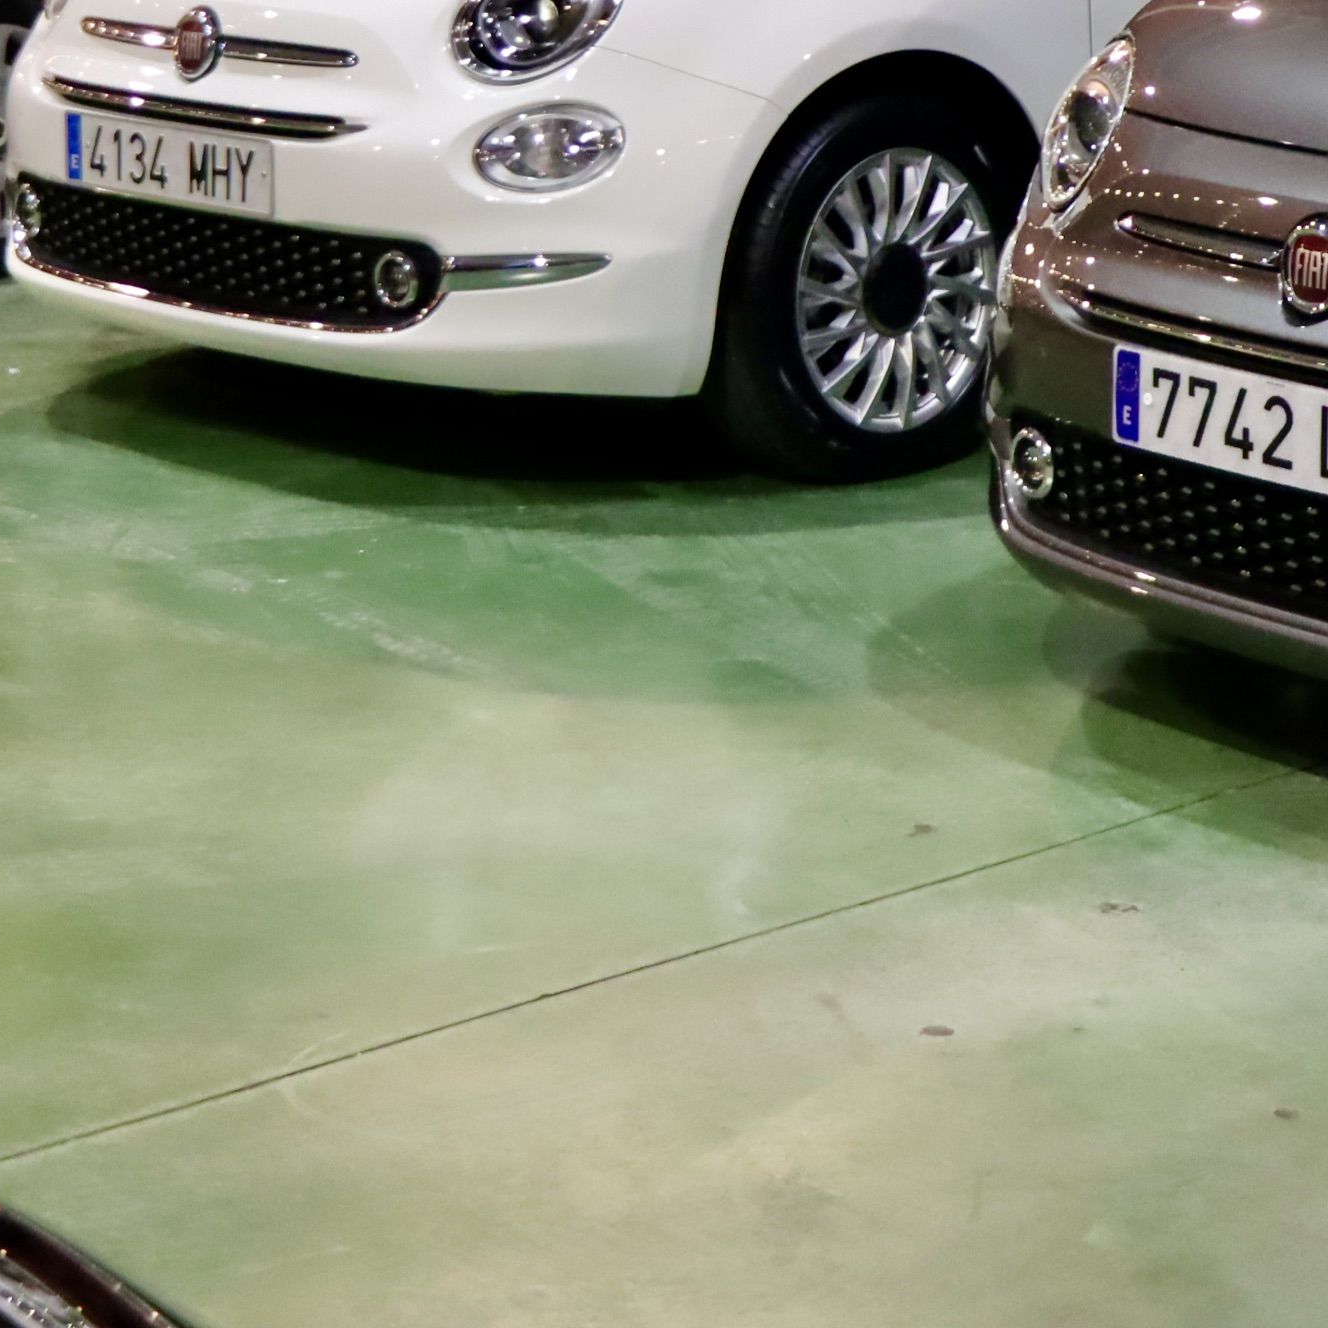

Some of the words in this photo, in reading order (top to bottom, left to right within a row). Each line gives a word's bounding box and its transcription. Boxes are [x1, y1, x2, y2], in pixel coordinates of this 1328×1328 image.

[90, 125, 168, 190] 4134
[189, 140, 255, 203] MHY
[1122, 404, 1133, 426] E
[1152, 366, 1294, 471] 7742
